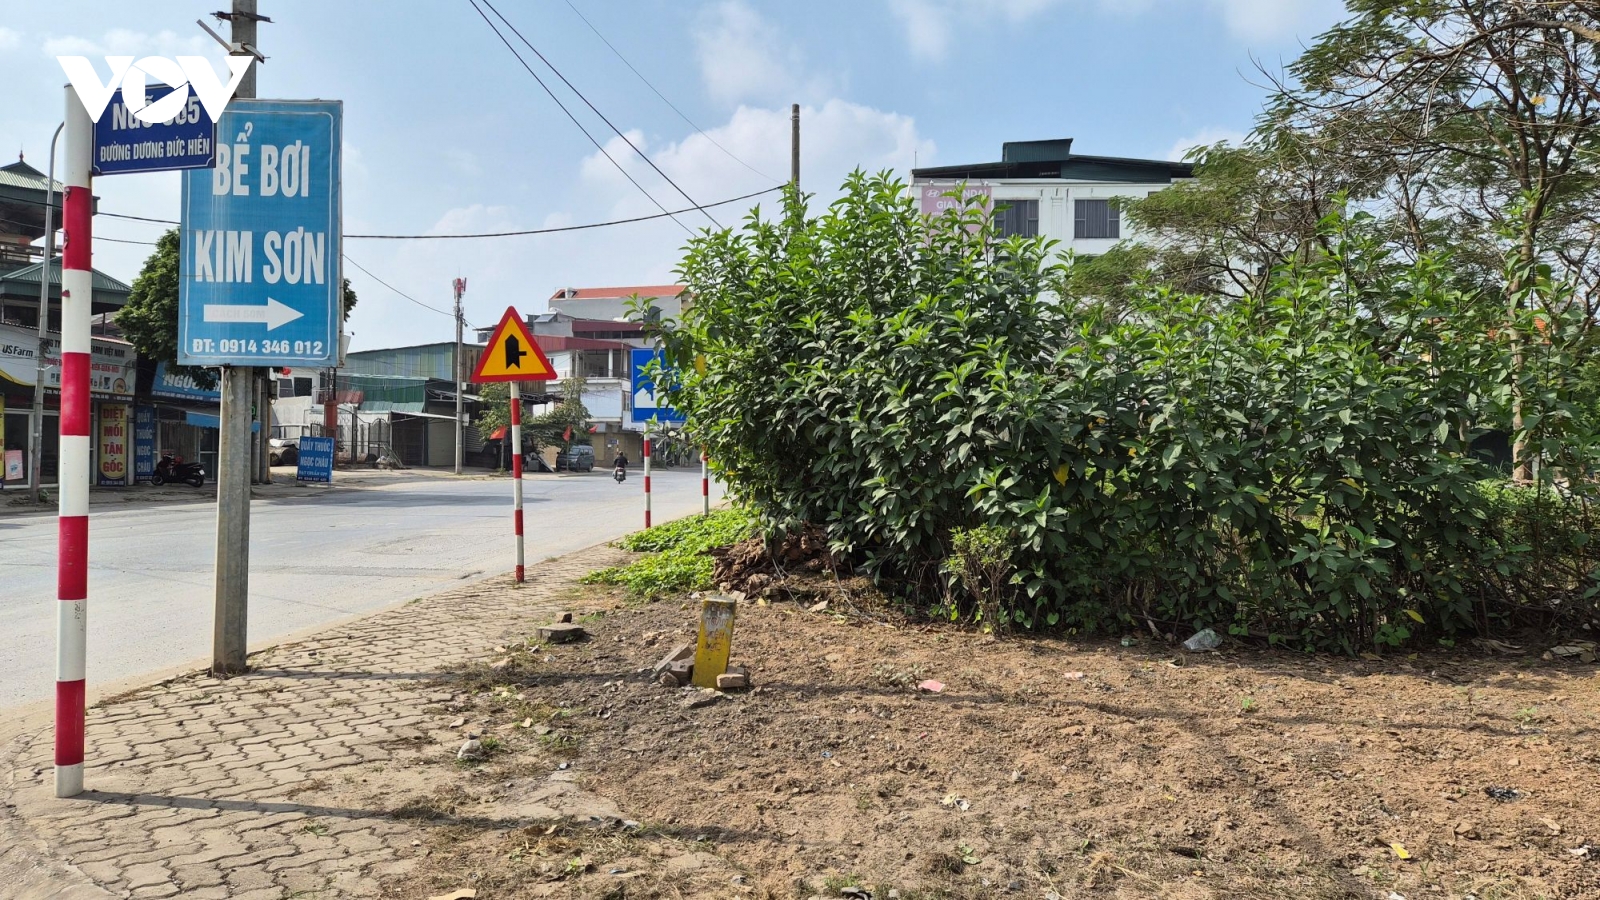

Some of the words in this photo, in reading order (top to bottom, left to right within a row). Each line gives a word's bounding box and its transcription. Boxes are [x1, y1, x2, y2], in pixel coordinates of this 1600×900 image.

[100, 141, 131, 162] ĐƯỜNG
[133, 141, 164, 160] DƯƠNG
[166, 136, 185, 157] ĐỨC
[187, 133, 210, 156] HIỀN
[212, 121, 252, 196] BỂ
[260, 139, 310, 197] BƠI
[936, 201, 953, 209] GIA
[195, 230, 253, 283] KIM
[263, 226, 325, 284] SƠN
[192, 339, 215, 353] ĐT:
[220, 339, 257, 353] 0914
[262, 340, 290, 354] 346
[294, 341, 323, 354] 012
[103, 406, 124, 421] DIỆT
[103, 423, 123, 437] MỐI
[103, 442, 123, 457] TẬN
[103, 458, 123, 472] GỐC
